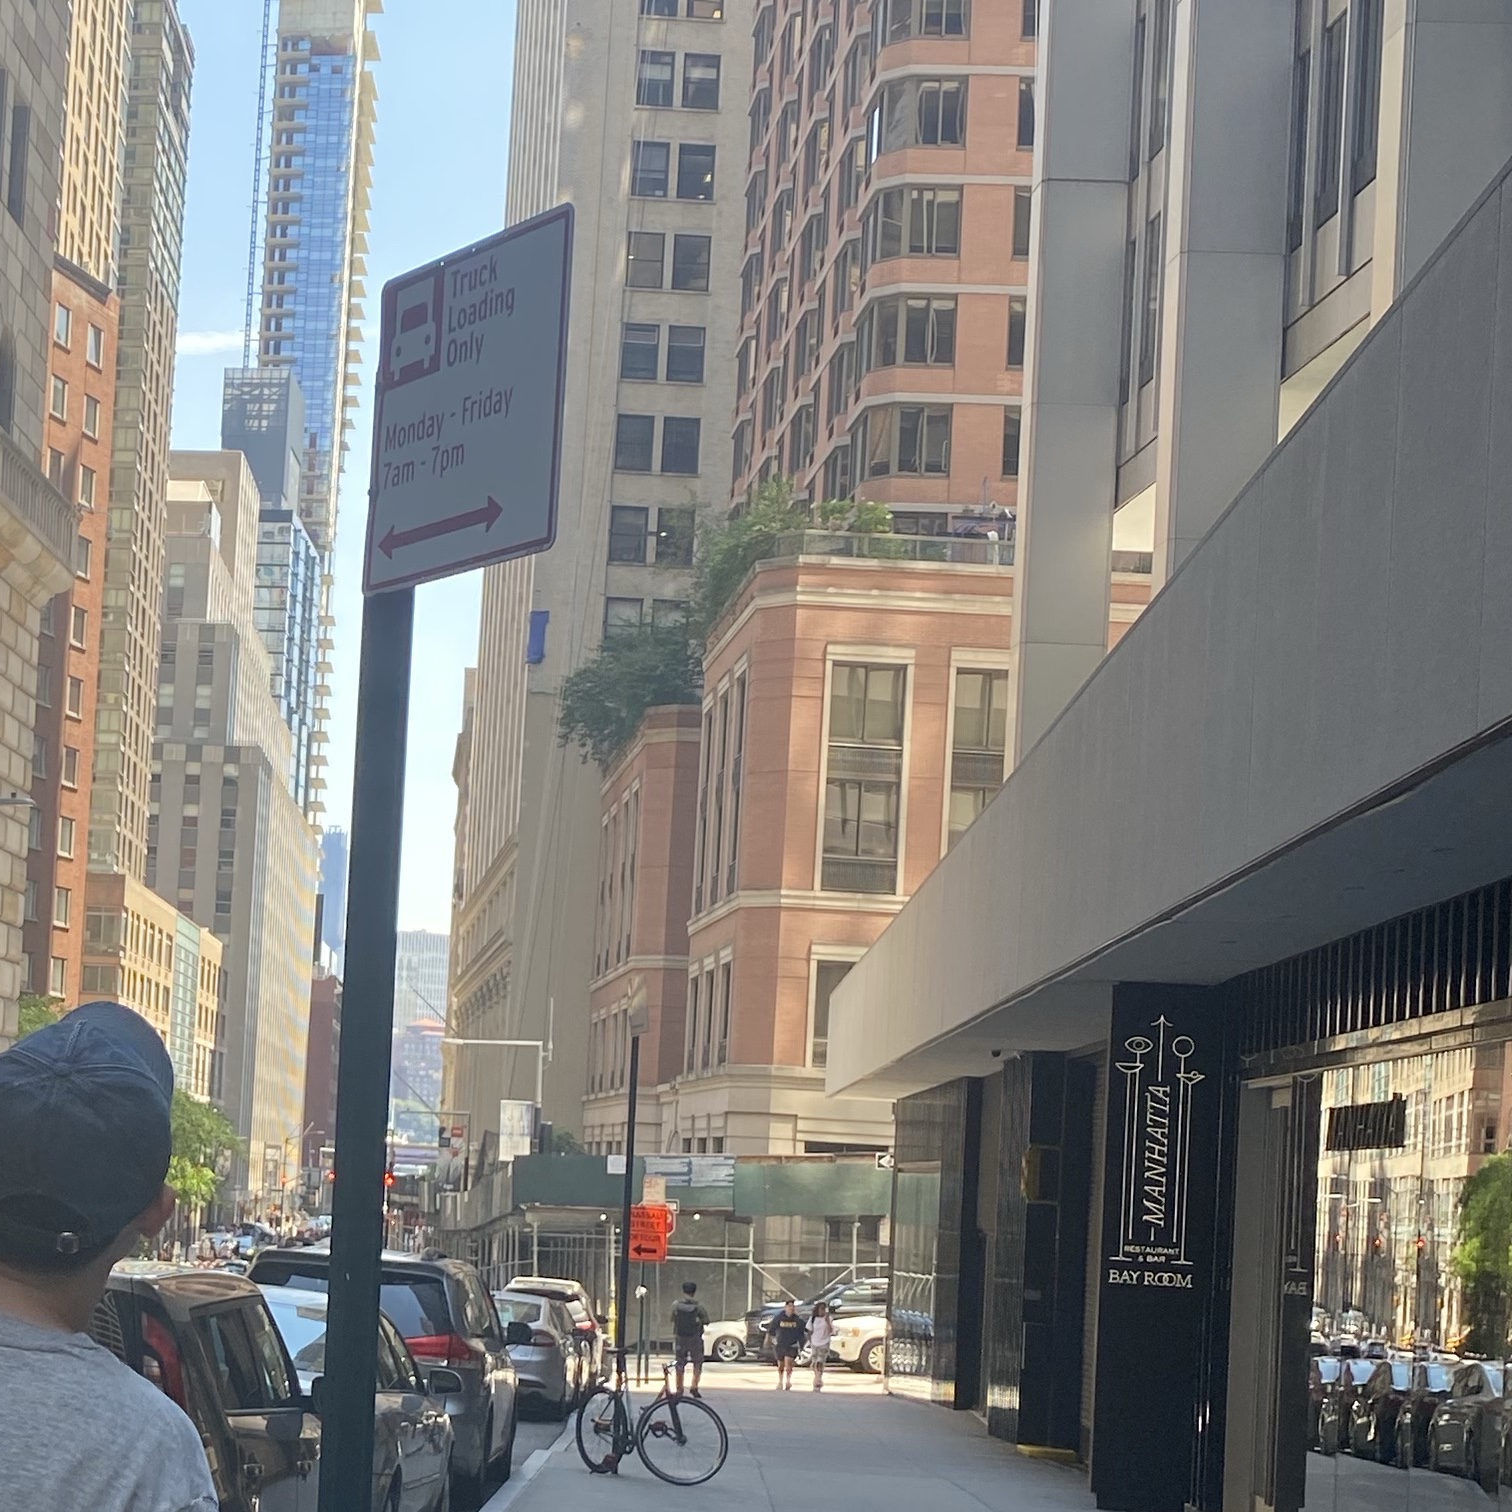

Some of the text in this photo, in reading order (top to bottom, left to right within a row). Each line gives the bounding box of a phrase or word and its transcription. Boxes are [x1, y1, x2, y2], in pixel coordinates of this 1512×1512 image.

[451, 255, 498, 298] Truck
[448, 287, 515, 334] Loading
[447, 330, 484, 367] Only
[384, 411, 444, 453] Monday
[462, 386, 513, 425] Friday
[384, 460, 415, 490] 7am
[432, 443, 465, 478] 7pm
[1142, 1085, 1170, 1227] MANHATTA
[1124, 1245, 1180, 1255] RESTAURANT
[1146, 1254, 1166, 1263] BAR
[1108, 1269, 1193, 1288] BAY ROOM
